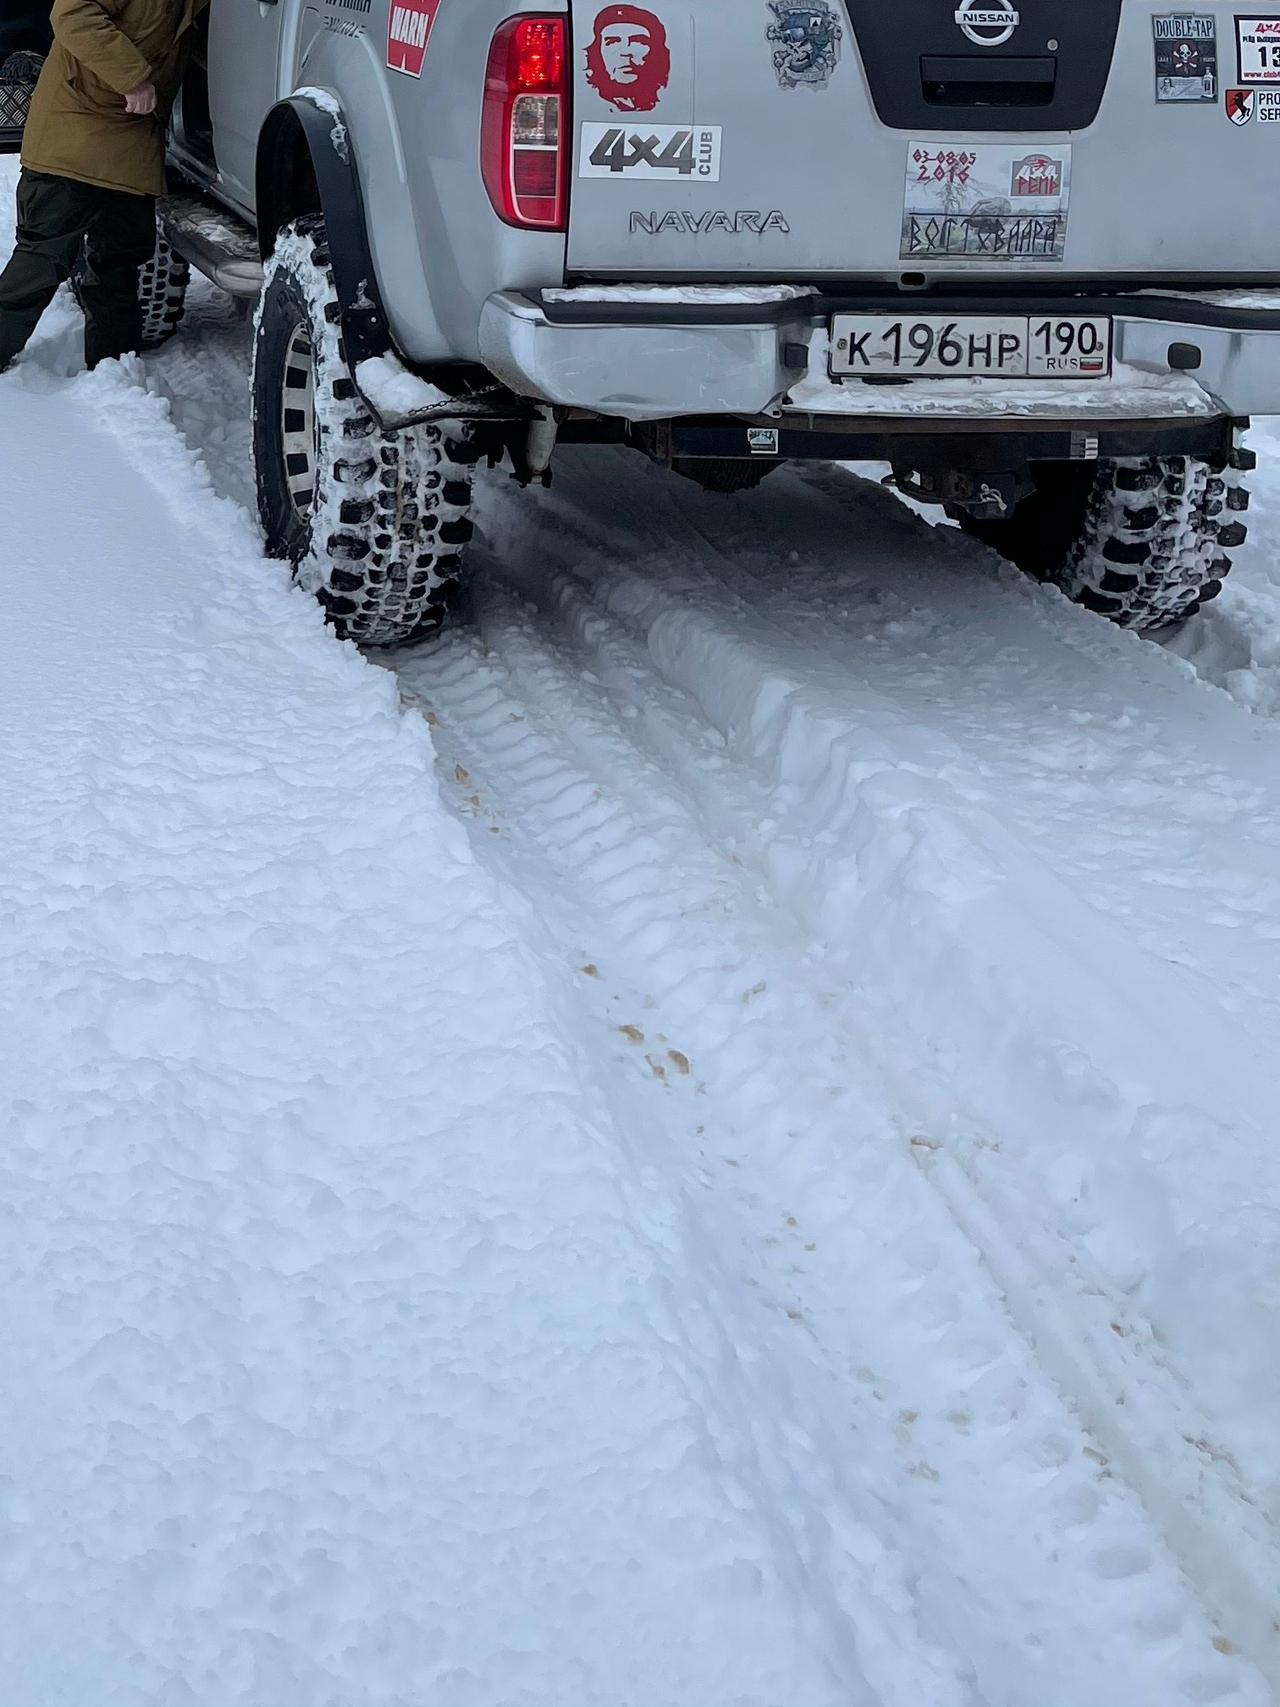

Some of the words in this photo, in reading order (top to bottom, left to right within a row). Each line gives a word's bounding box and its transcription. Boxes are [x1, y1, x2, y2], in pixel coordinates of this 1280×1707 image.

[389, 5, 430, 49] WARN
[962, 12, 1015, 23] NISSAN
[698, 130, 714, 177] CLUB
[629, 210, 791, 234] NAVARA
[1033, 320, 1099, 356] 190
[1045, 357, 1080, 371] RUS
